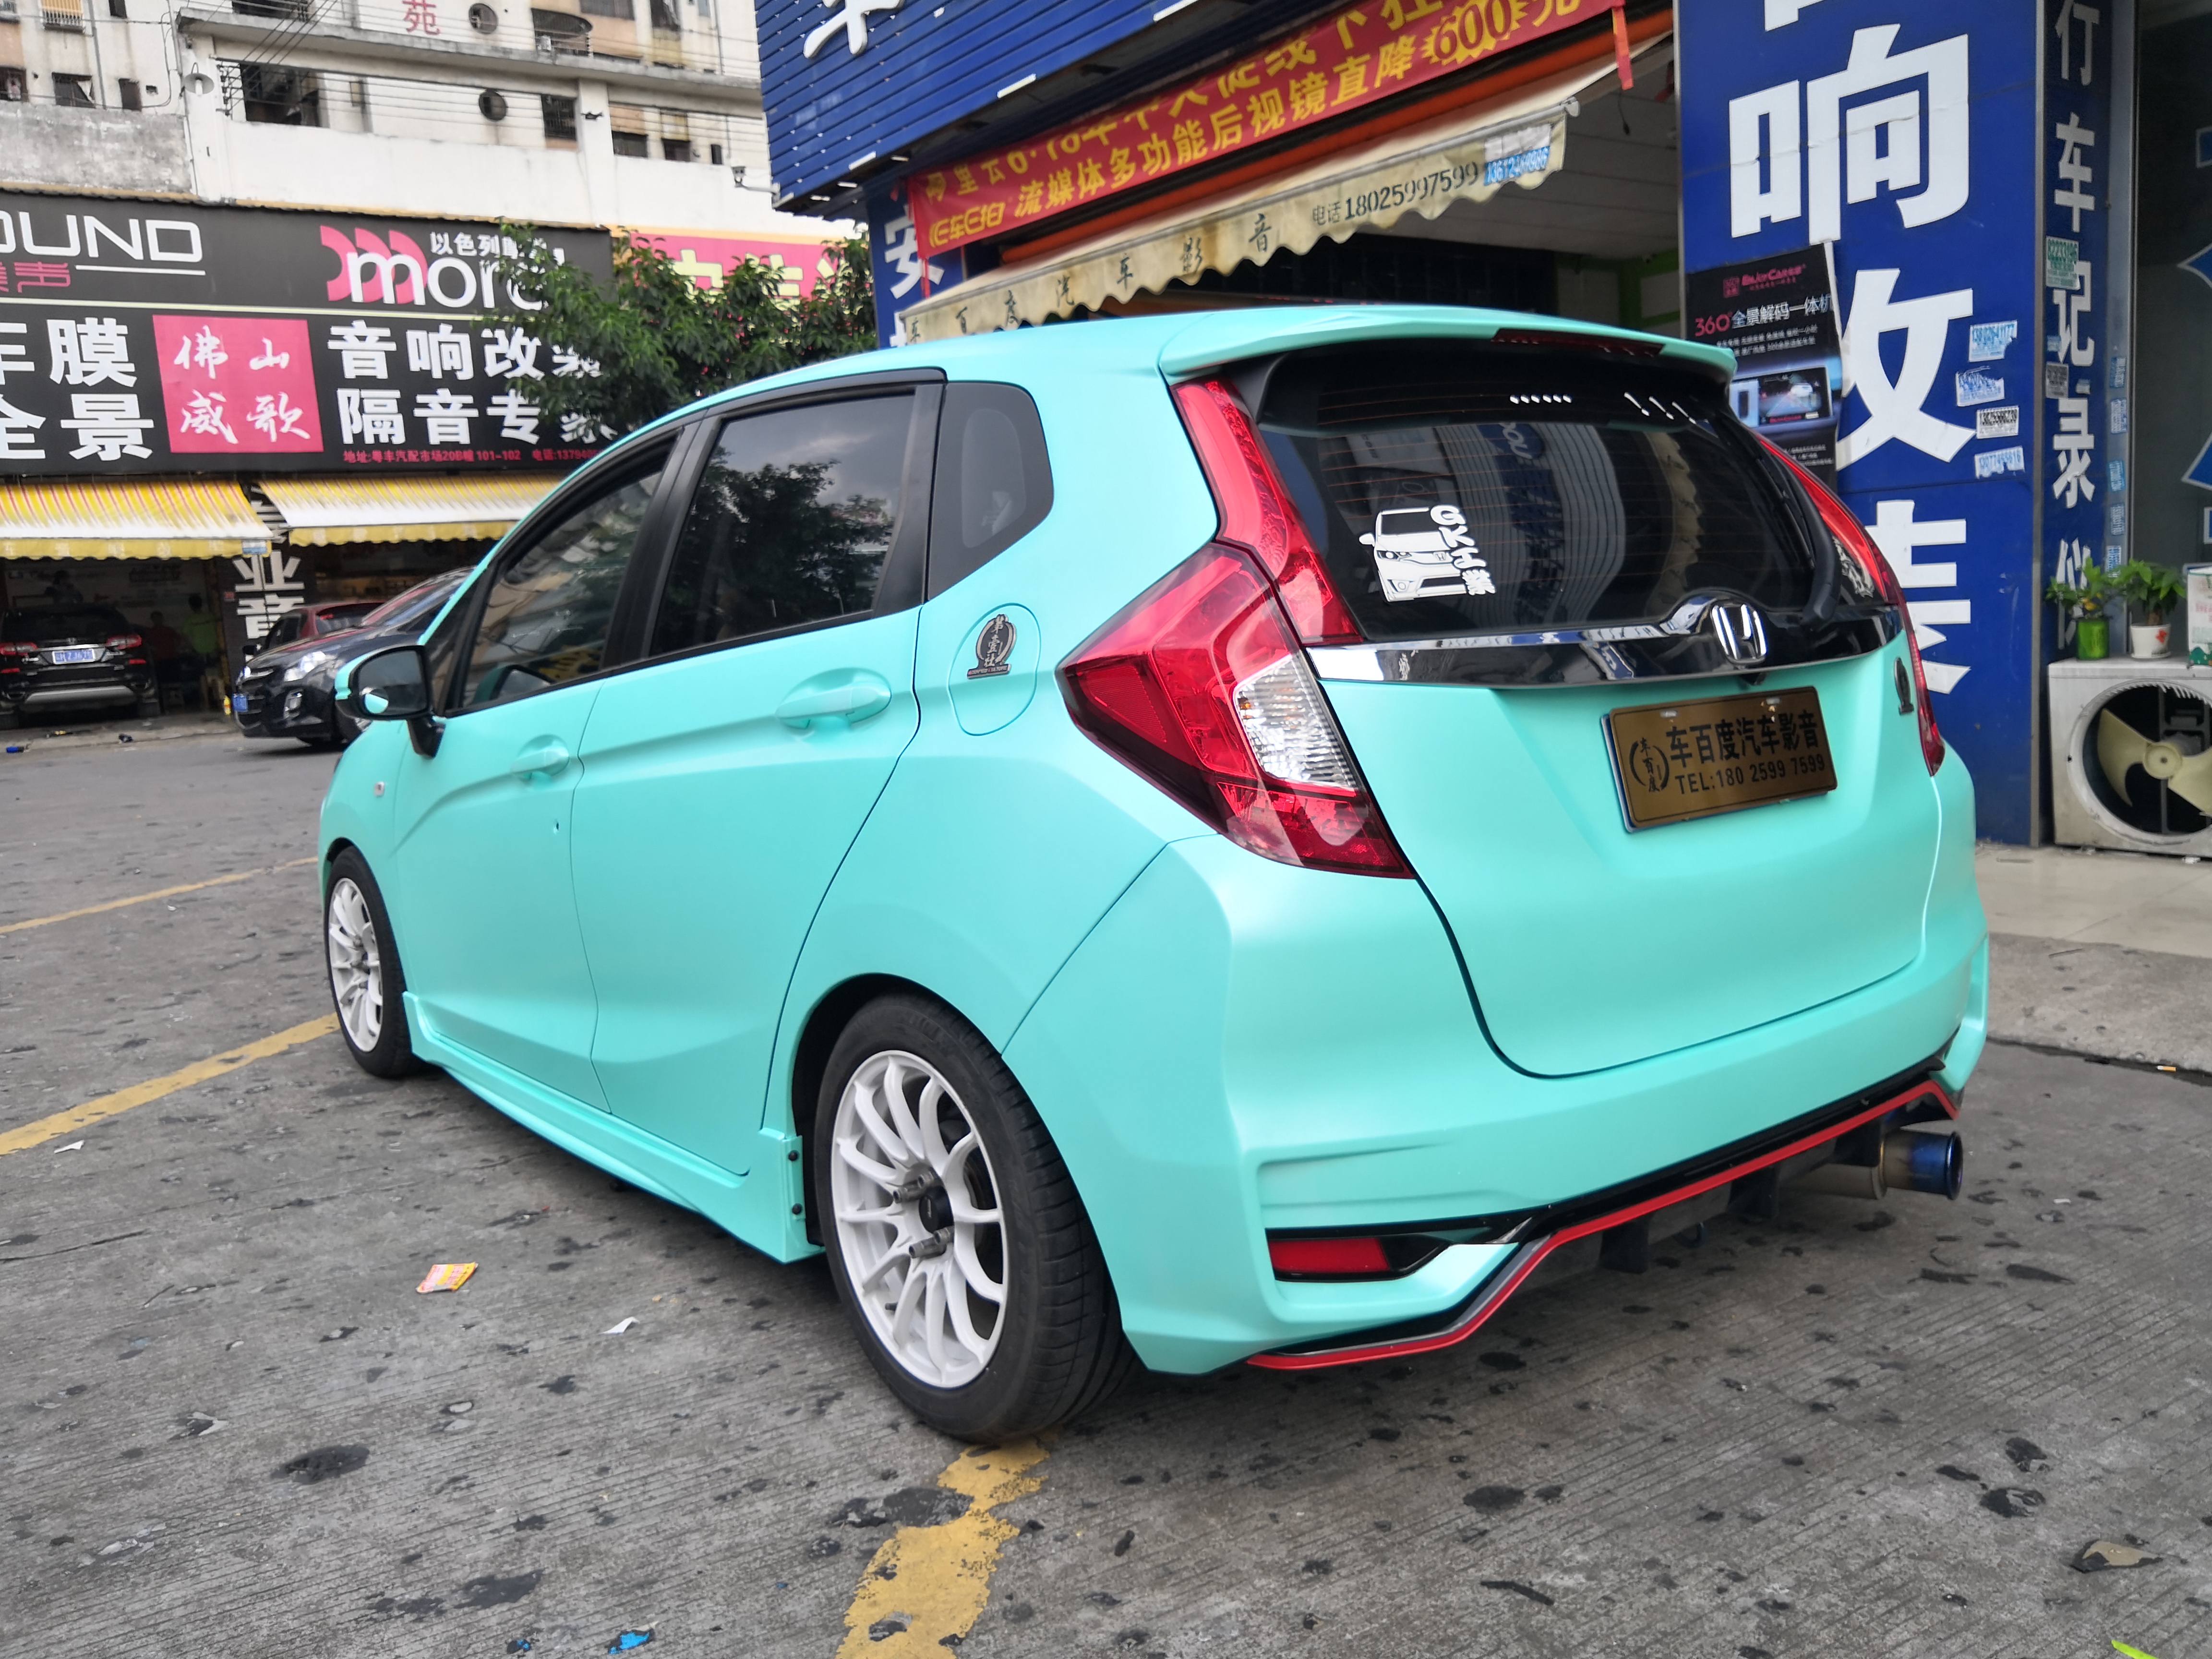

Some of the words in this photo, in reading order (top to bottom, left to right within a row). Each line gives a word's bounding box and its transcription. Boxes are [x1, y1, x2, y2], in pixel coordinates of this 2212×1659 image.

[402, 0, 440, 36] 苑
[1345, 160, 1479, 220] 18025997599
[0, 210, 204, 262] UND
[173, 324, 291, 380] 佛山
[477, 450, 521, 462] 101-102
[1666, 709, 1818, 769] 车百度汽车影音
[1750, 760, 1786, 783] 2599
[1791, 753, 1826, 776] 7599
